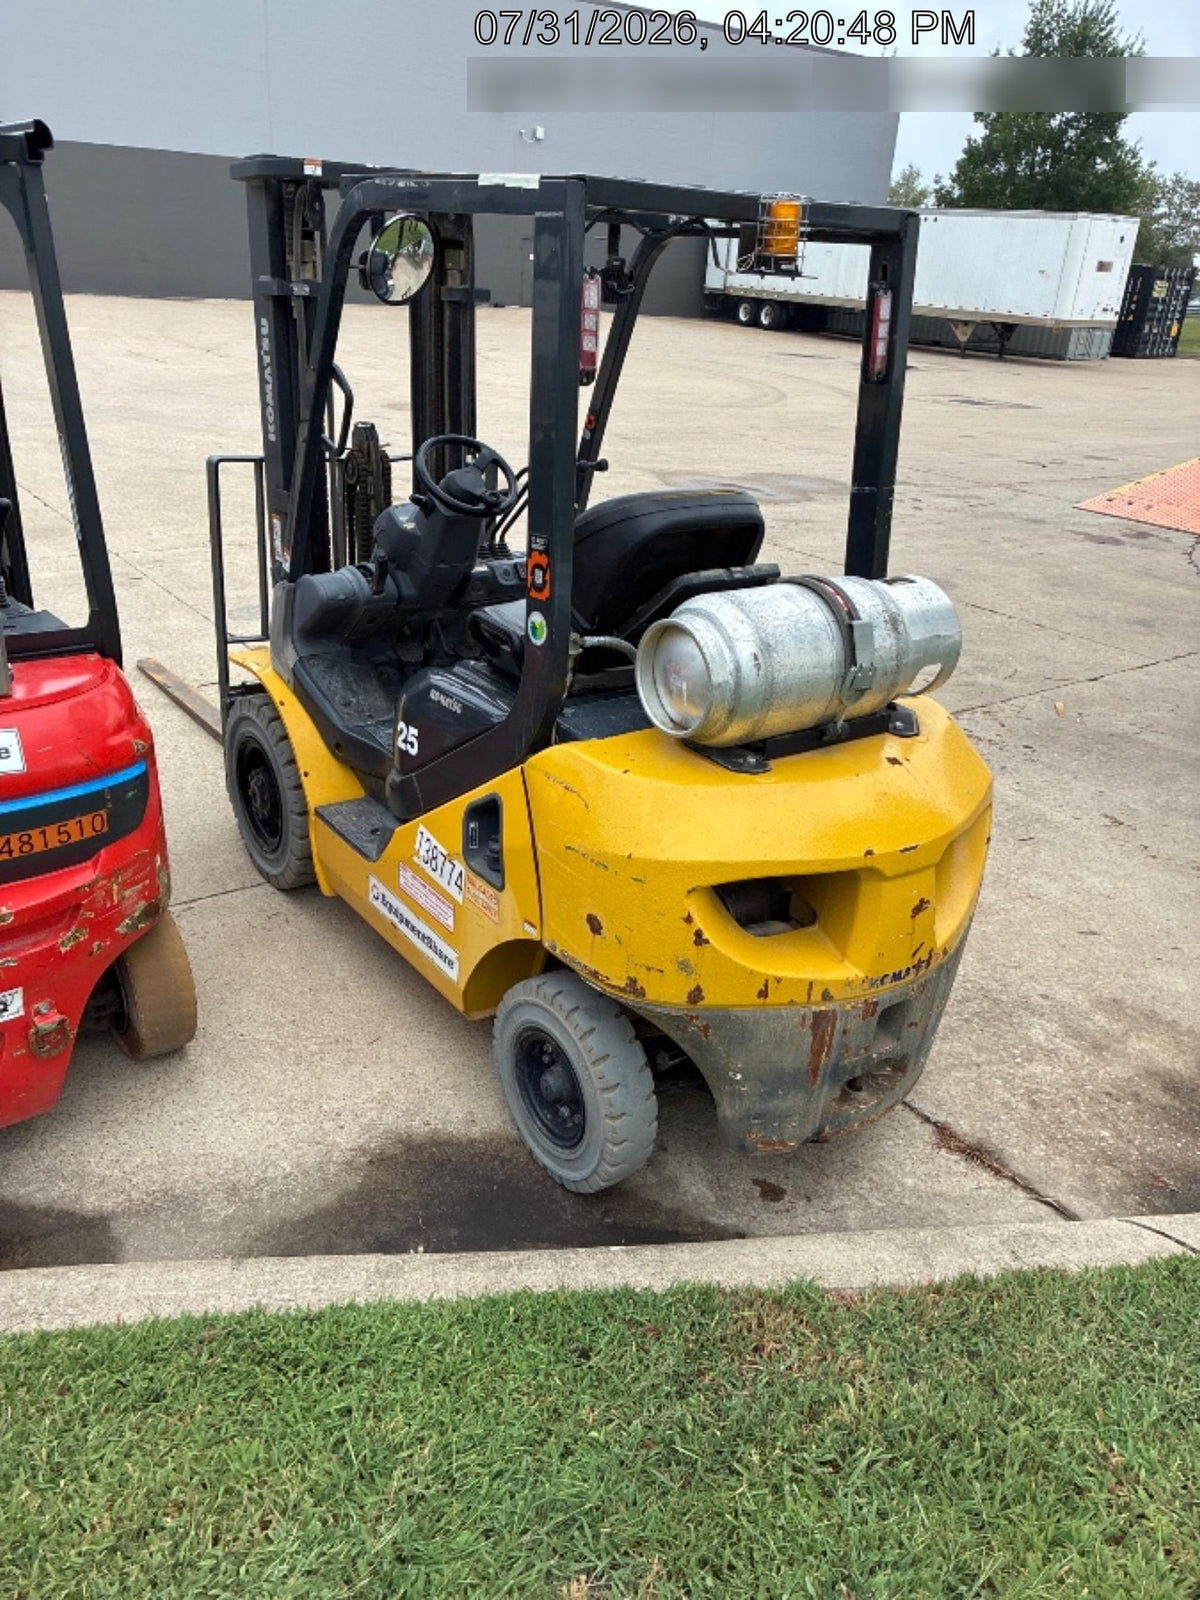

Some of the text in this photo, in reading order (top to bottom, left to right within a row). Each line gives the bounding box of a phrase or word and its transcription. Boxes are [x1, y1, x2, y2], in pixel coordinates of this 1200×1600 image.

[260, 318, 277, 442] KOMATSU
[397, 721, 419, 757] 25
[418, 829, 464, 896] 138774
[380, 892, 456, 970] EquipmentShare
